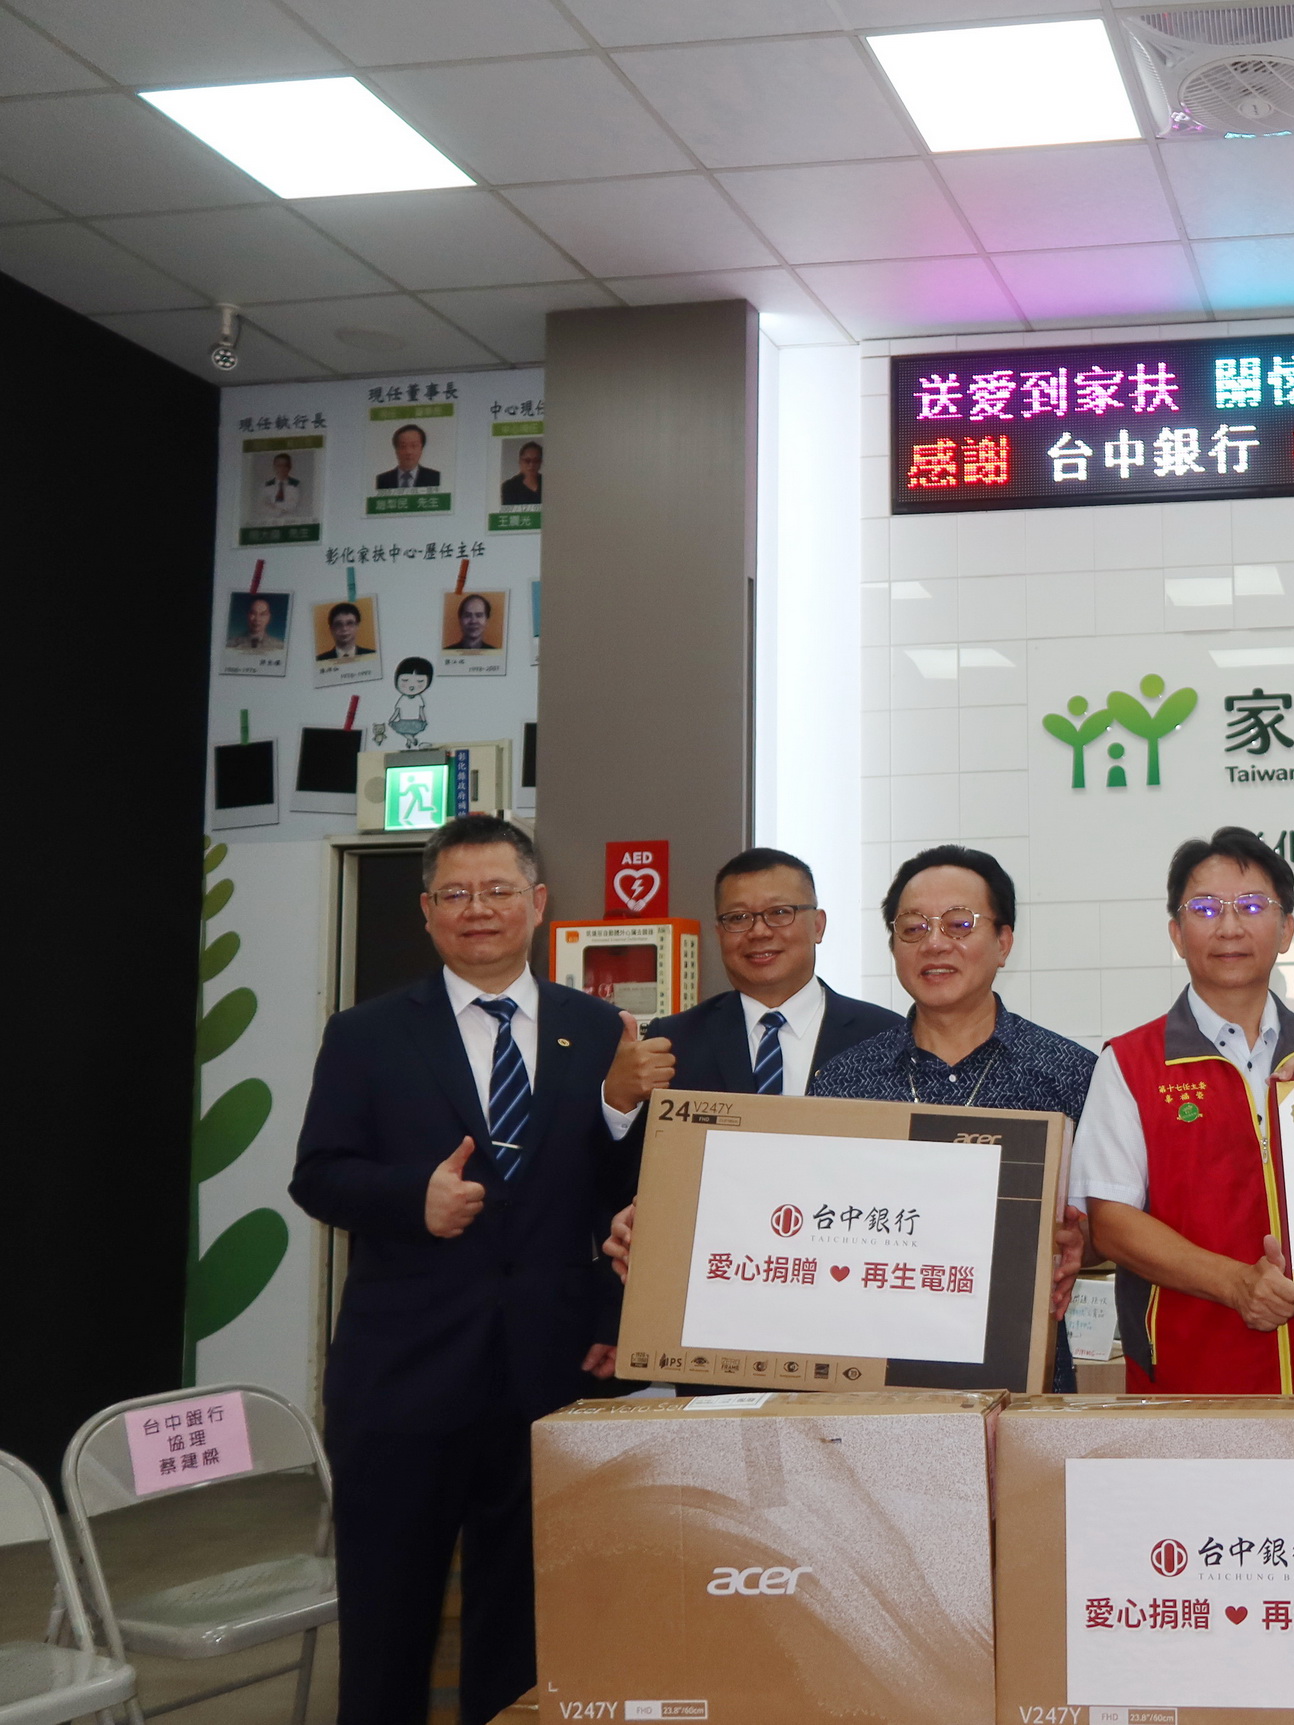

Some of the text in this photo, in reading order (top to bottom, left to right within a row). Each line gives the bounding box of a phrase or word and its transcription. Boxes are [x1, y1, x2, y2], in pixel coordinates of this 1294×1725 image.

[368, 381, 458, 403] 現任董事長
[914, 362, 1179, 421] 送愛到家扶
[239, 412, 327, 433] 現任執行長
[907, 435, 1010, 490] 感謝
[1047, 424, 1260, 482] 台中銀行
[621, 851, 653, 865] AED
[659, 1099, 733, 1122] 24 V247Y
[813, 1204, 920, 1236] 台中銀行
[810, 1235, 918, 1248] TAICHUNG BANK
[706, 1252, 975, 1294] 愛心捐贈 再生電腦
[143, 1405, 224, 1436] 台中銀行
[167, 1429, 206, 1452] 協理
[706, 1565, 813, 1595] acer
[1198, 1572, 1275, 1582] TAICHUNG
[1084, 1597, 1211, 1631] 愛心捐贈
[559, 1701, 618, 1720] V247Y
[636, 1706, 653, 1715] FHD
[1019, 1706, 1081, 1725] V247Y
[1101, 1713, 1119, 1722] FHD
